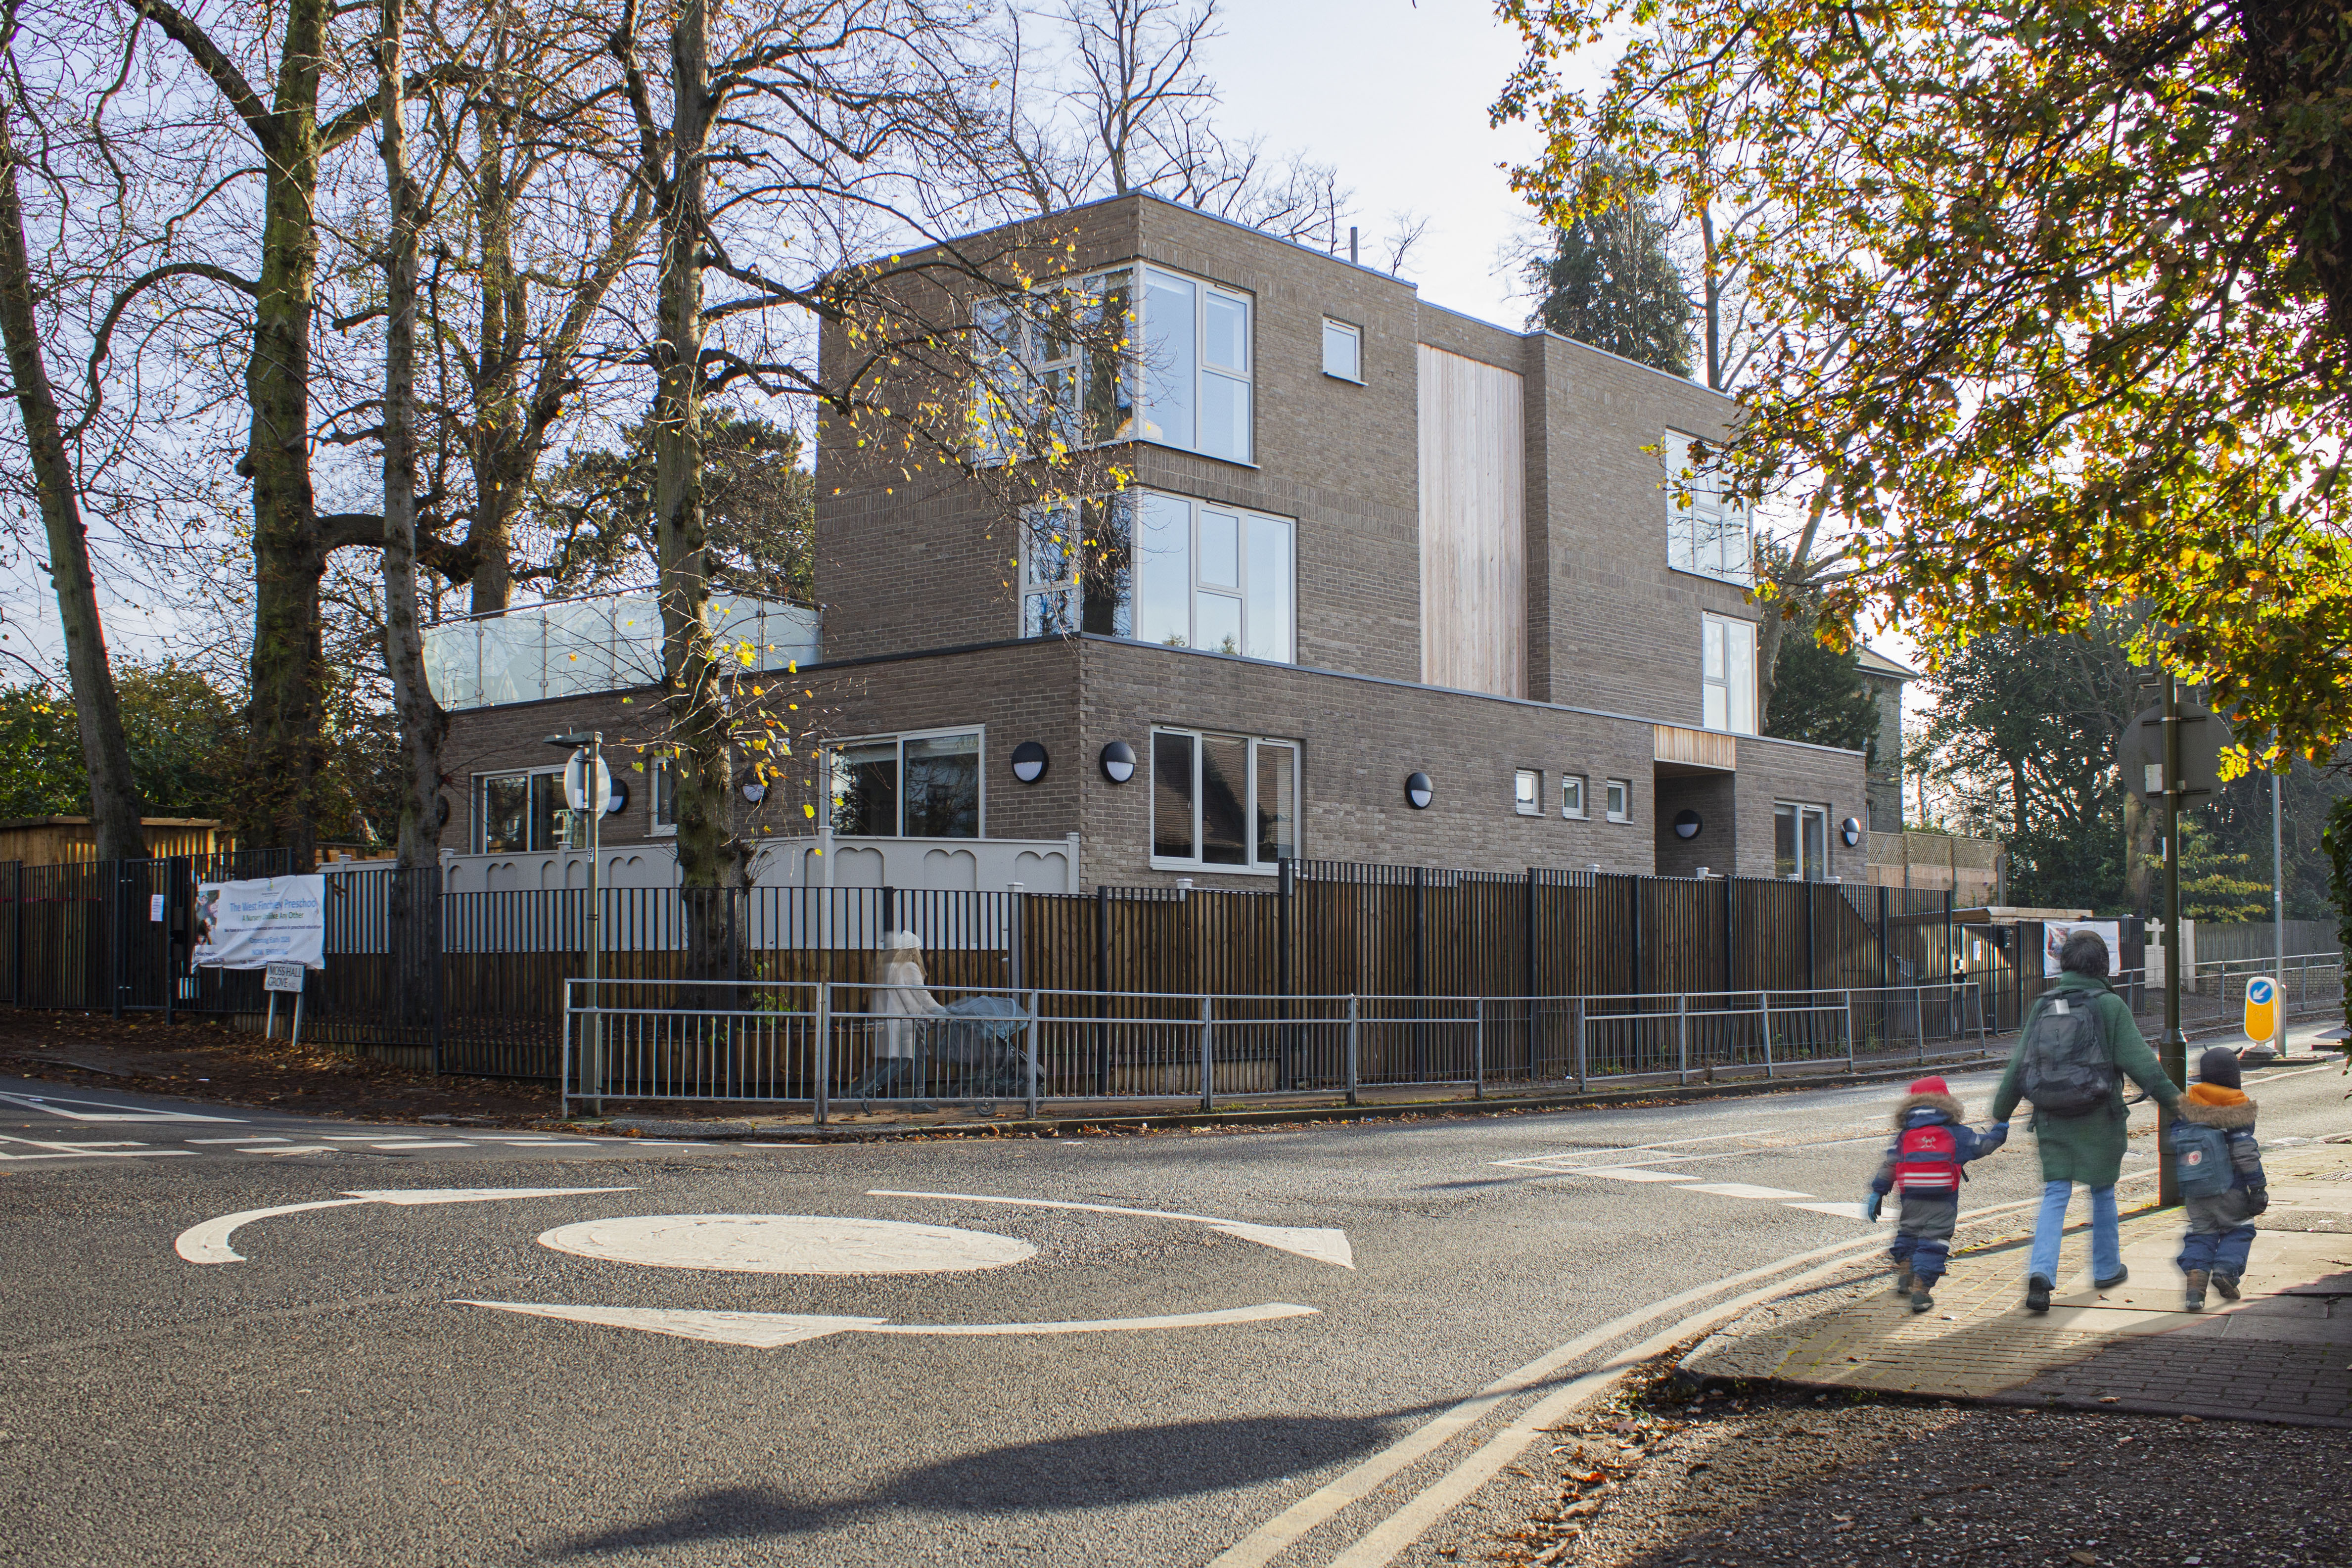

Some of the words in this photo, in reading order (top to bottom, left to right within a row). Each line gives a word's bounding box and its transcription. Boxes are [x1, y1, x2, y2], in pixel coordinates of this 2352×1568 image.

[230, 902, 241, 912] The
[242, 902, 257, 911] West
[269, 966, 285, 976] MOSS
[286, 967, 301, 977] HALL
[268, 976, 288, 987] GROVE
